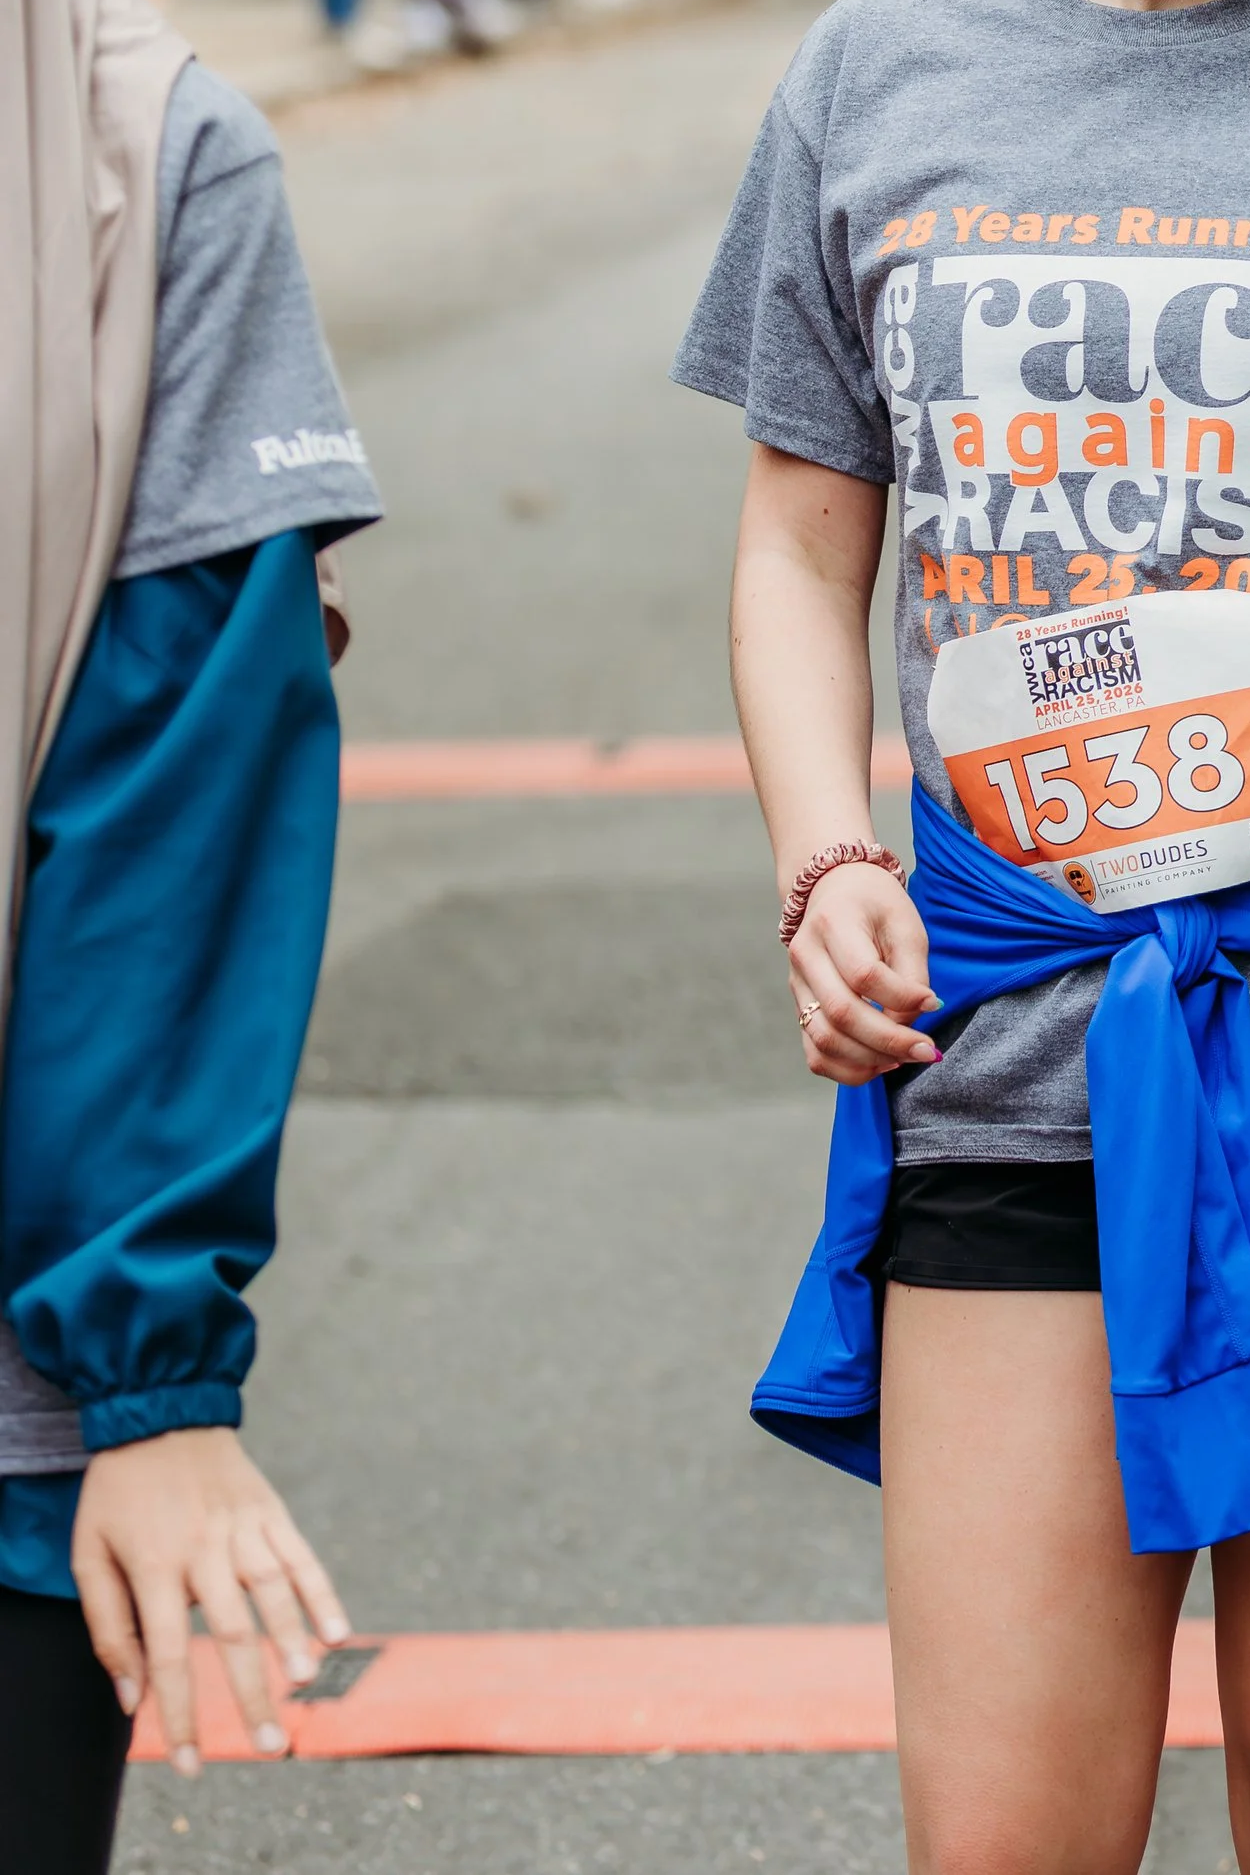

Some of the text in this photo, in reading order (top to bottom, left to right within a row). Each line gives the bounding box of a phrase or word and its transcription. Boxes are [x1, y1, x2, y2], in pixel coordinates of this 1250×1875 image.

[876, 209, 938, 257] 28
[951, 204, 1099, 245] Years
[884, 261, 949, 537] ywca
[1016, 606, 1128, 641] 28 Years Running!
[1035, 624, 1136, 671] race
[1019, 642, 1046, 705] ywca
[1041, 665, 1142, 702] RACISM
[1044, 651, 1135, 684] against
[1035, 683, 1143, 718] APRIL 25, 2026
[1036, 696, 1146, 731] LANCASTER, PA
[984, 713, 1246, 852] 1538
[1105, 866, 1213, 895] PAINTING COMPANY
